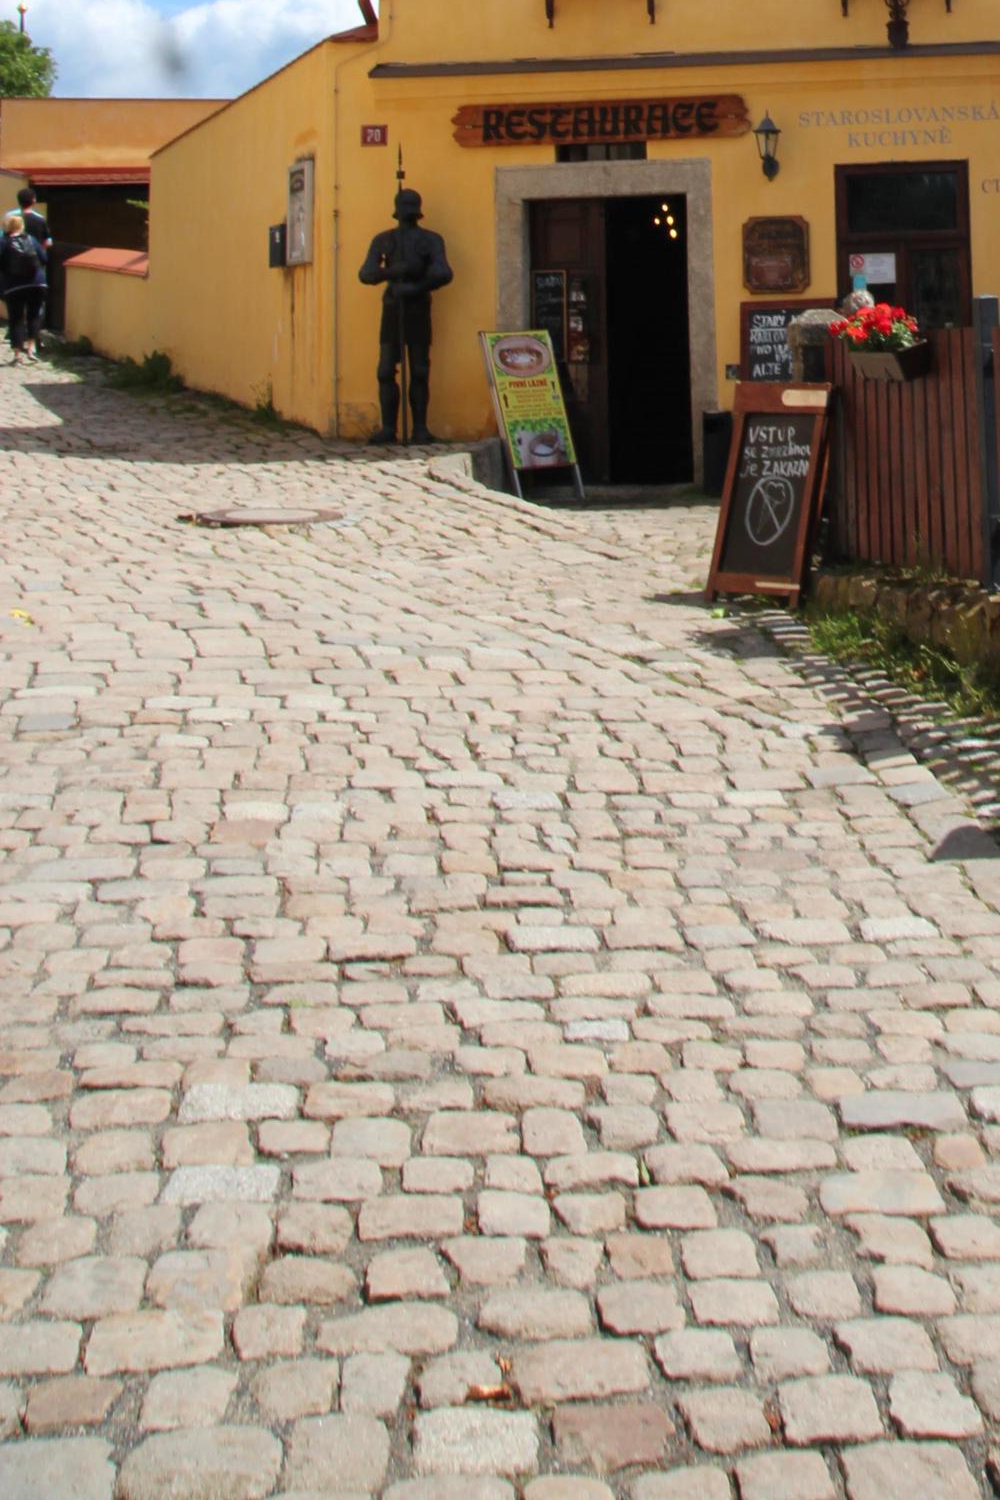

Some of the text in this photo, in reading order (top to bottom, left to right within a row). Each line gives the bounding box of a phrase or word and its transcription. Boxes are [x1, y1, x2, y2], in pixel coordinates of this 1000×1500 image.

[482, 101, 720, 142] RESTAURACE
[798, 100, 1000, 128] STAROSLOVANSKÁ
[848, 125, 953, 148] KUCHYNĚ
[749, 425, 796, 445] VSTUP
